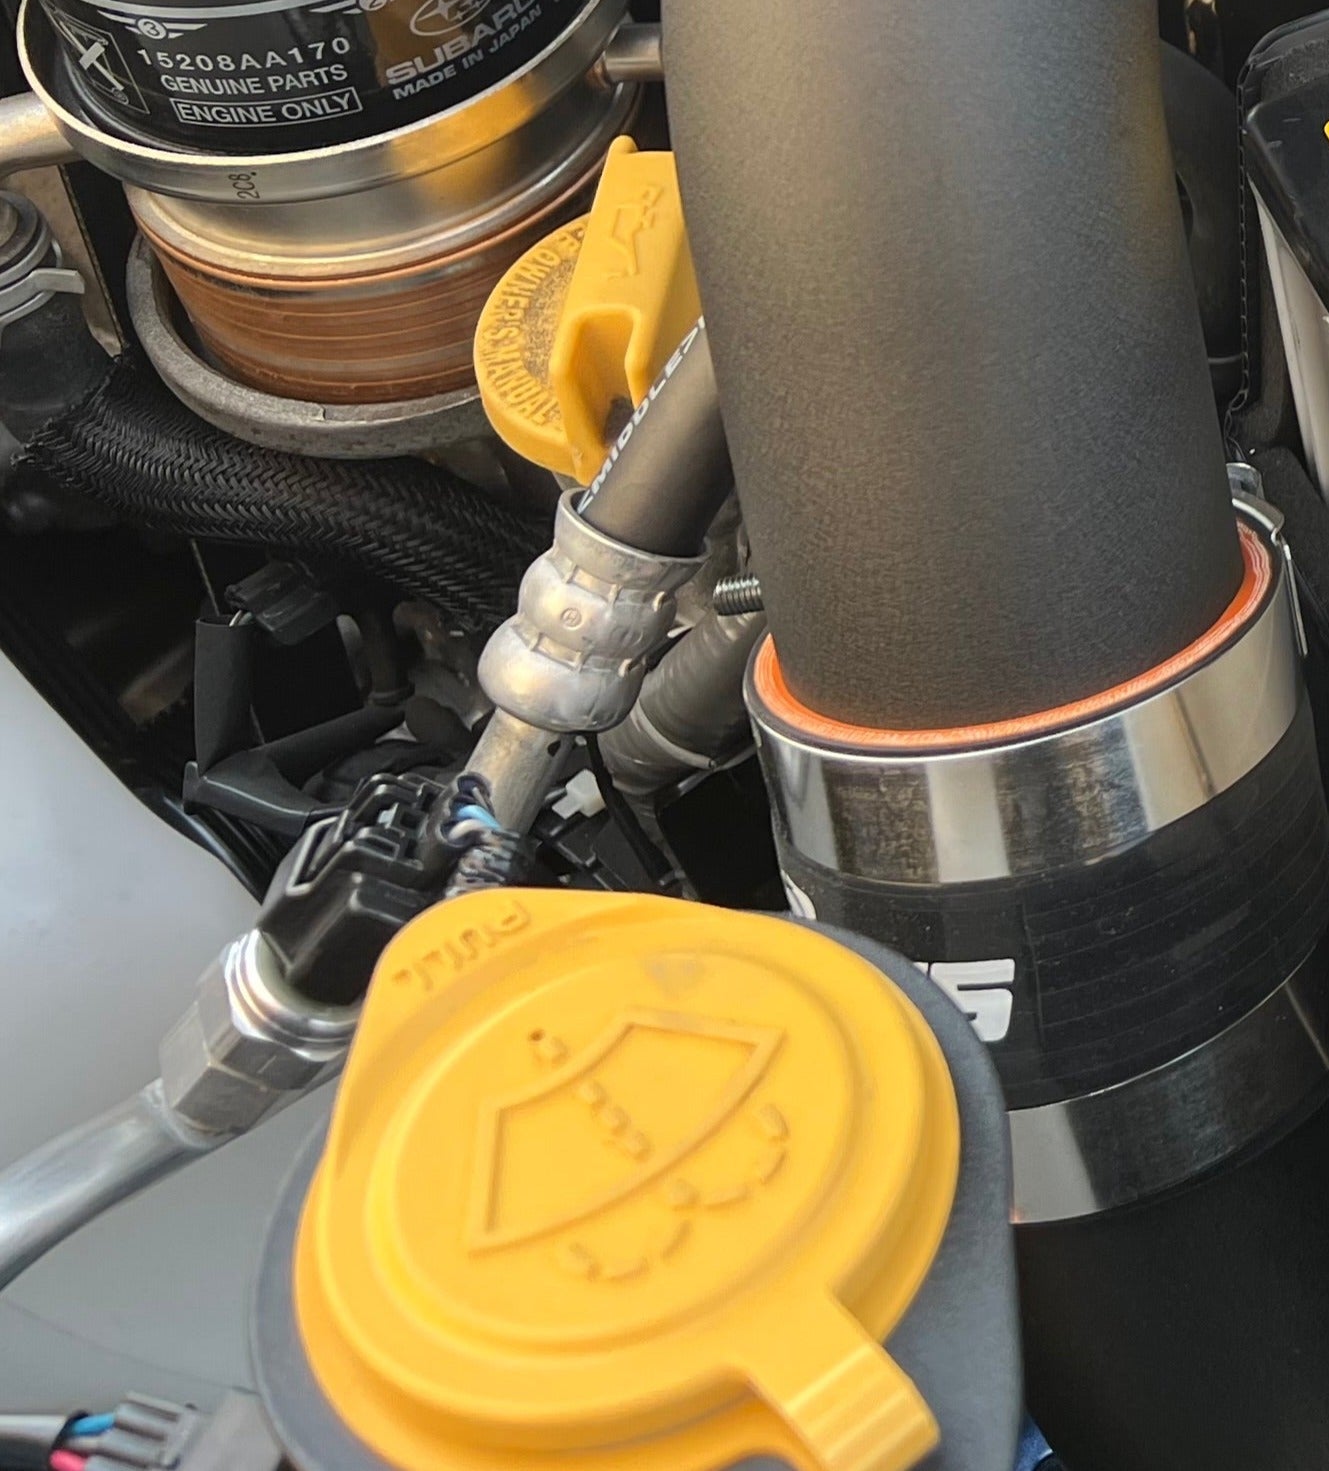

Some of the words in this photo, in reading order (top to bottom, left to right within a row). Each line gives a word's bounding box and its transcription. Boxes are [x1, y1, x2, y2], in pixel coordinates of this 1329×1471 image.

[137, 36, 350, 72] 15208AA170
[393, 64, 457, 100] MADE
[462, 49, 485, 70] IN
[488, 4, 543, 54] JAPAN
[160, 74, 266, 96] GENUINE
[270, 64, 348, 93] PARTS
[176, 102, 277, 124] ENGINE
[281, 92, 352, 120] ONLY
